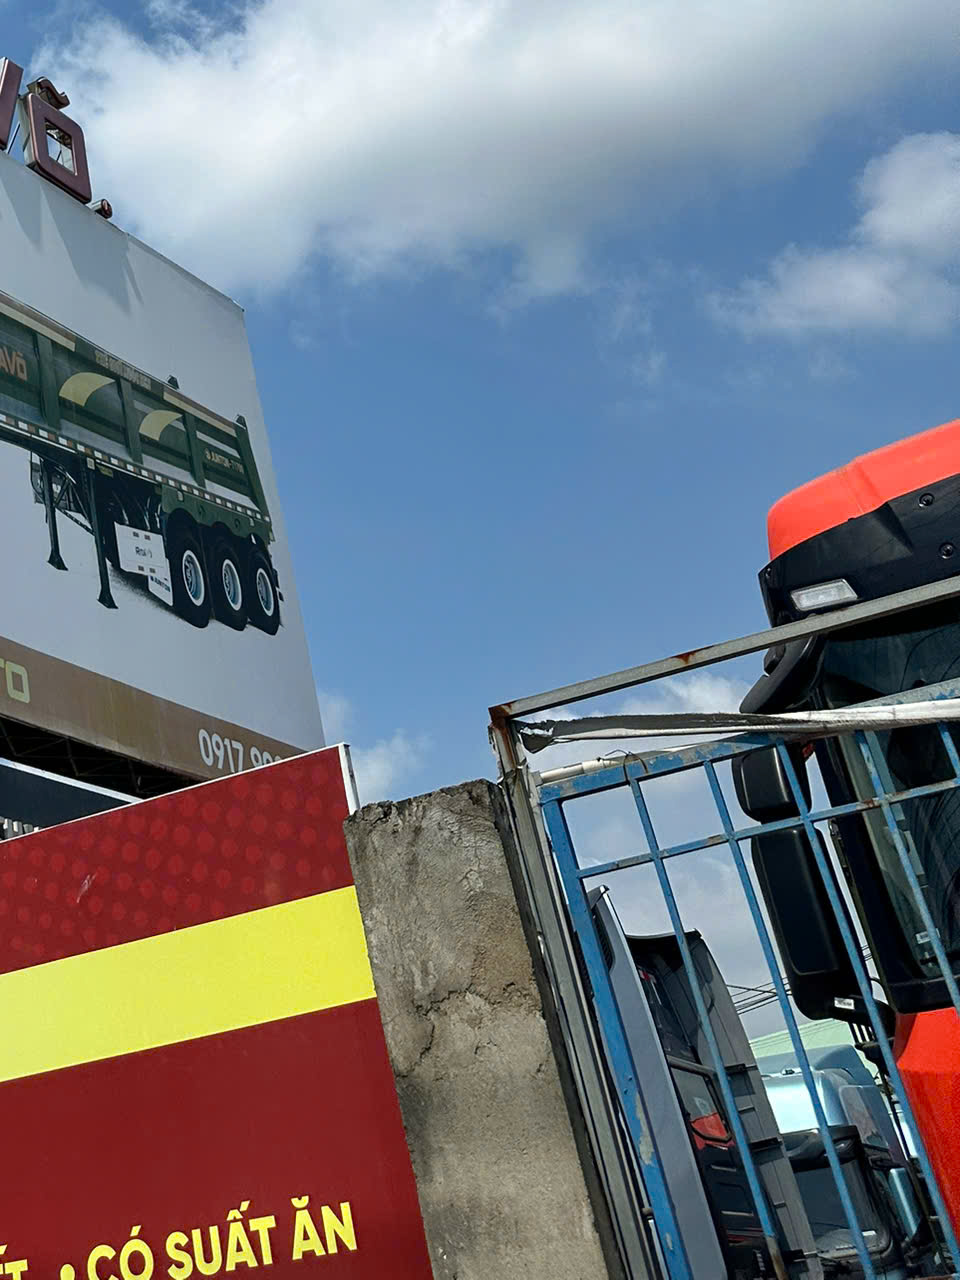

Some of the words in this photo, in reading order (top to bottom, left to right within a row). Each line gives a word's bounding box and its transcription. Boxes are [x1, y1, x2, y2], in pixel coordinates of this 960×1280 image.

[198, 729, 244, 773] 0917
[88, 1225, 154, 1280] CÓ
[165, 1200, 276, 1279] SUẤT
[292, 1196, 358, 1260] ĂN
